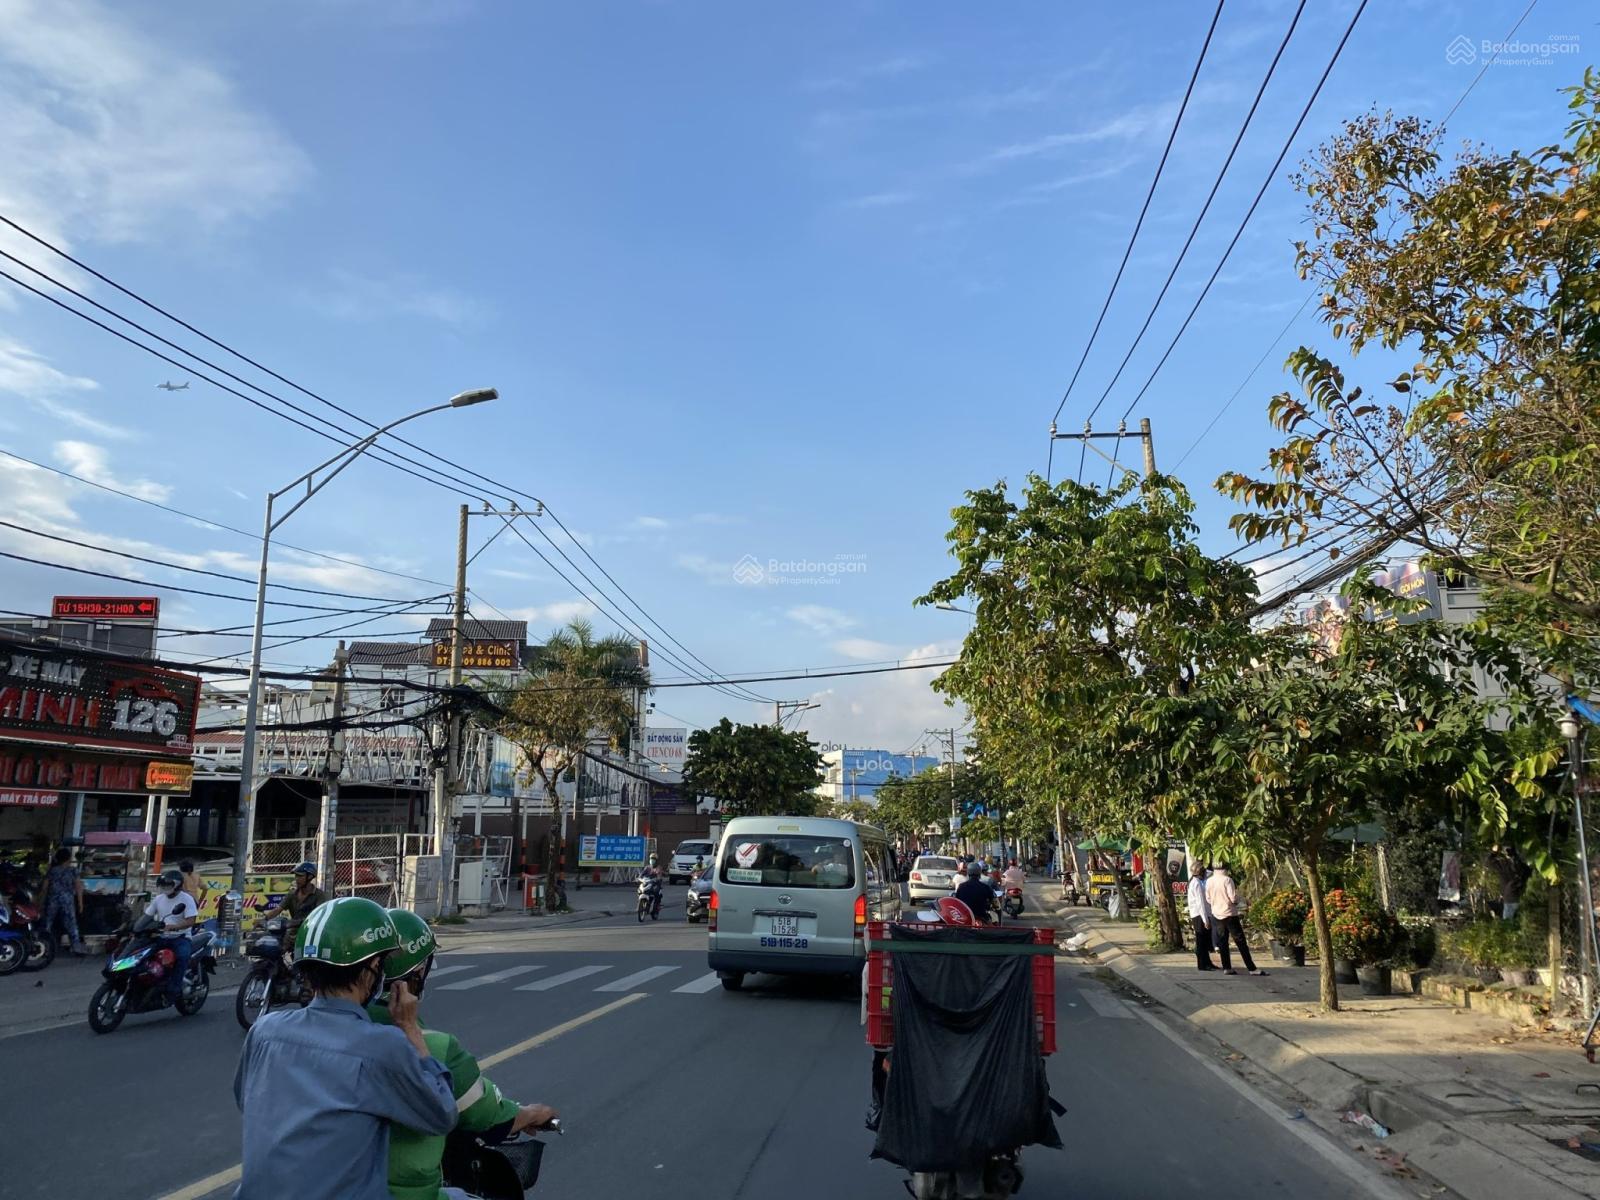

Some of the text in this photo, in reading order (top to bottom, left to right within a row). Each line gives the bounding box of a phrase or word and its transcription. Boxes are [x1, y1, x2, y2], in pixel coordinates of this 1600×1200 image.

[495, 658, 511, 667] 002
[110, 698, 179, 737] 126
[855, 754, 894, 771] yola
[778, 917, 792, 926] 51B
[362, 921, 393, 943] Grab
[407, 929, 432, 954] Grab
